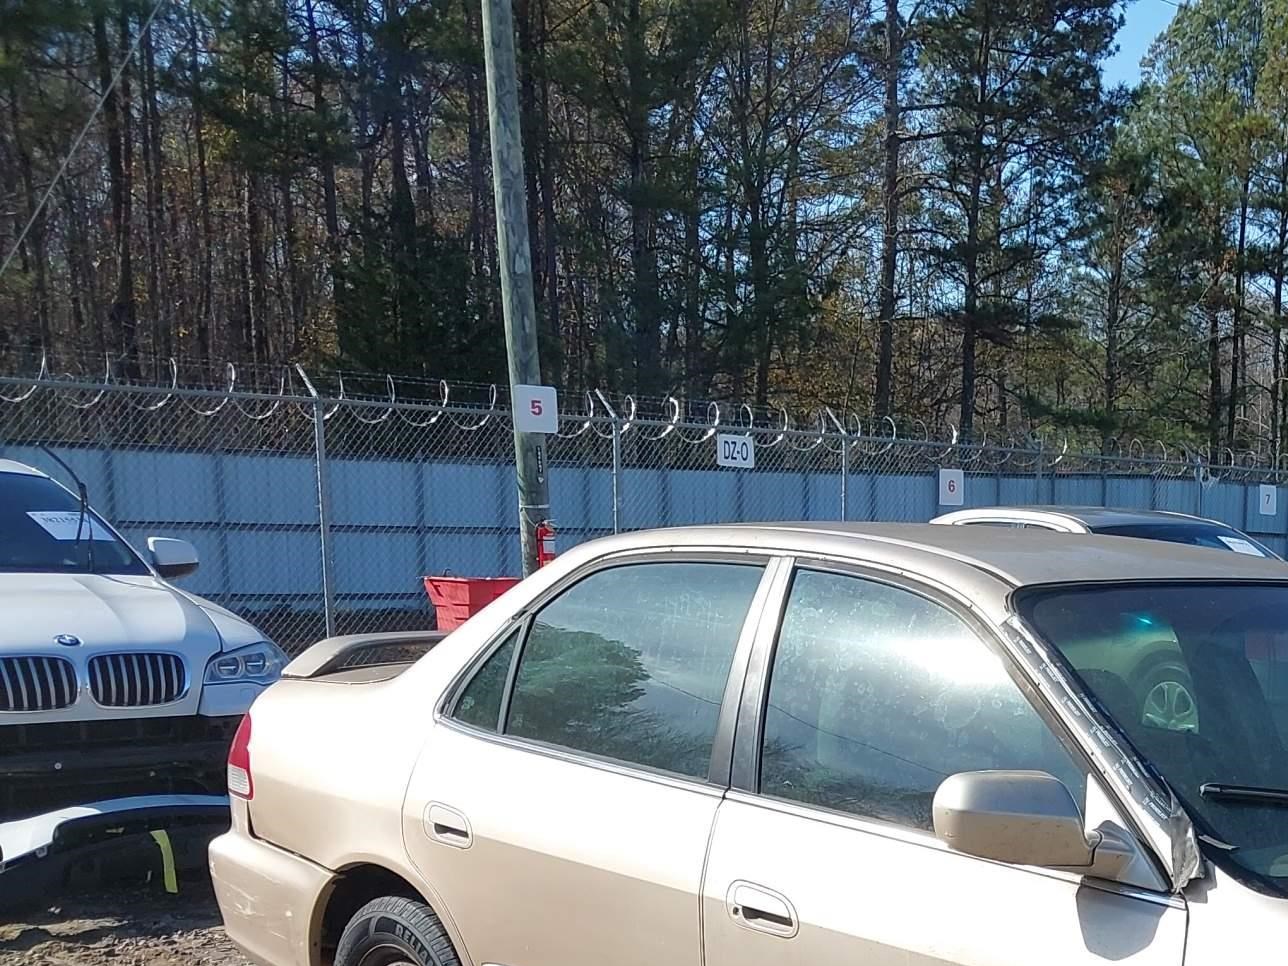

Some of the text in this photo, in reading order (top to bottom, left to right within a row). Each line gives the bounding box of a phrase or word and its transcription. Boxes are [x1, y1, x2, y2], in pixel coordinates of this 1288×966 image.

[530, 399, 543, 416] 5
[948, 479, 956, 493] 6
[1265, 494, 1271, 505] 7
